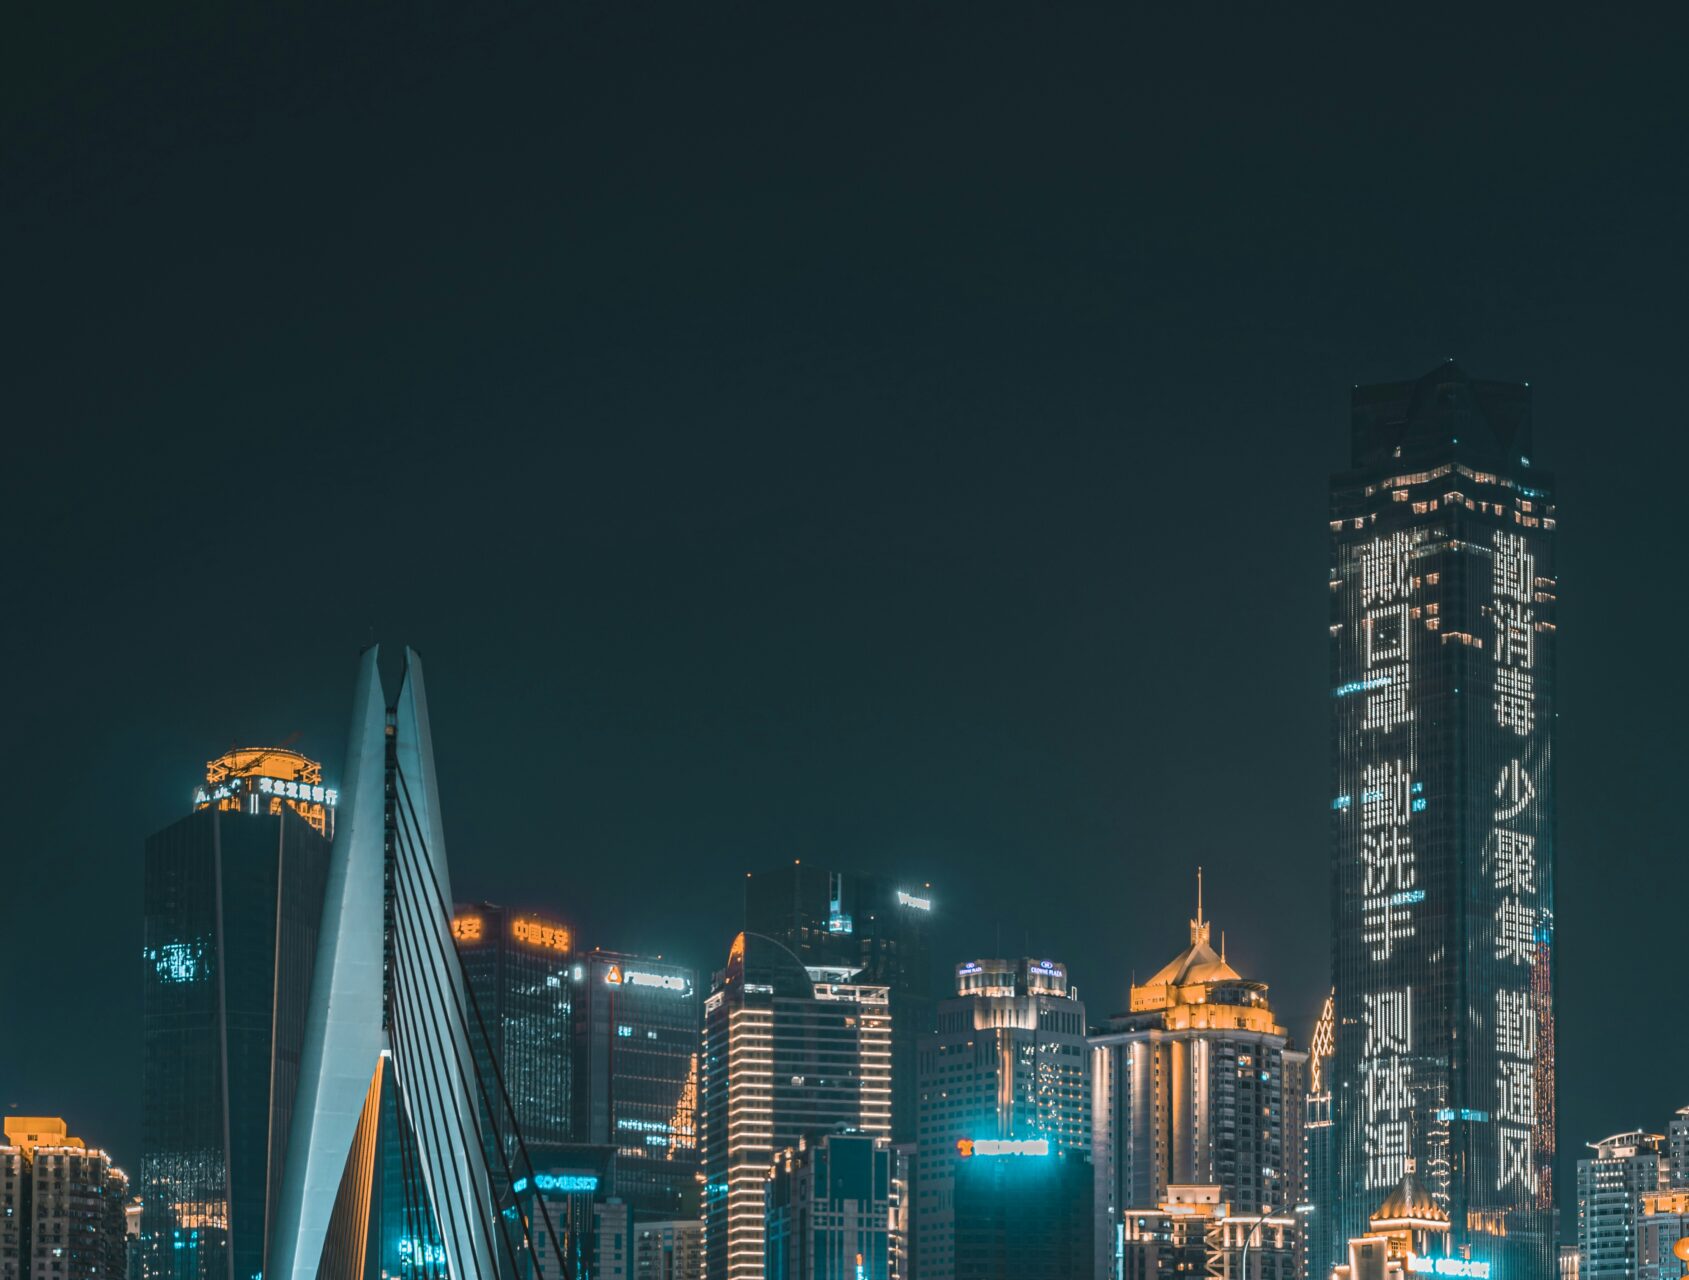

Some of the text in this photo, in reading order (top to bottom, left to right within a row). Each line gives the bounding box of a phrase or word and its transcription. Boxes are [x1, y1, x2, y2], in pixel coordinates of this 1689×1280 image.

[513, 920, 569, 951] 中国平安
[1031, 967, 1063, 977] CROWNE PLAZA
